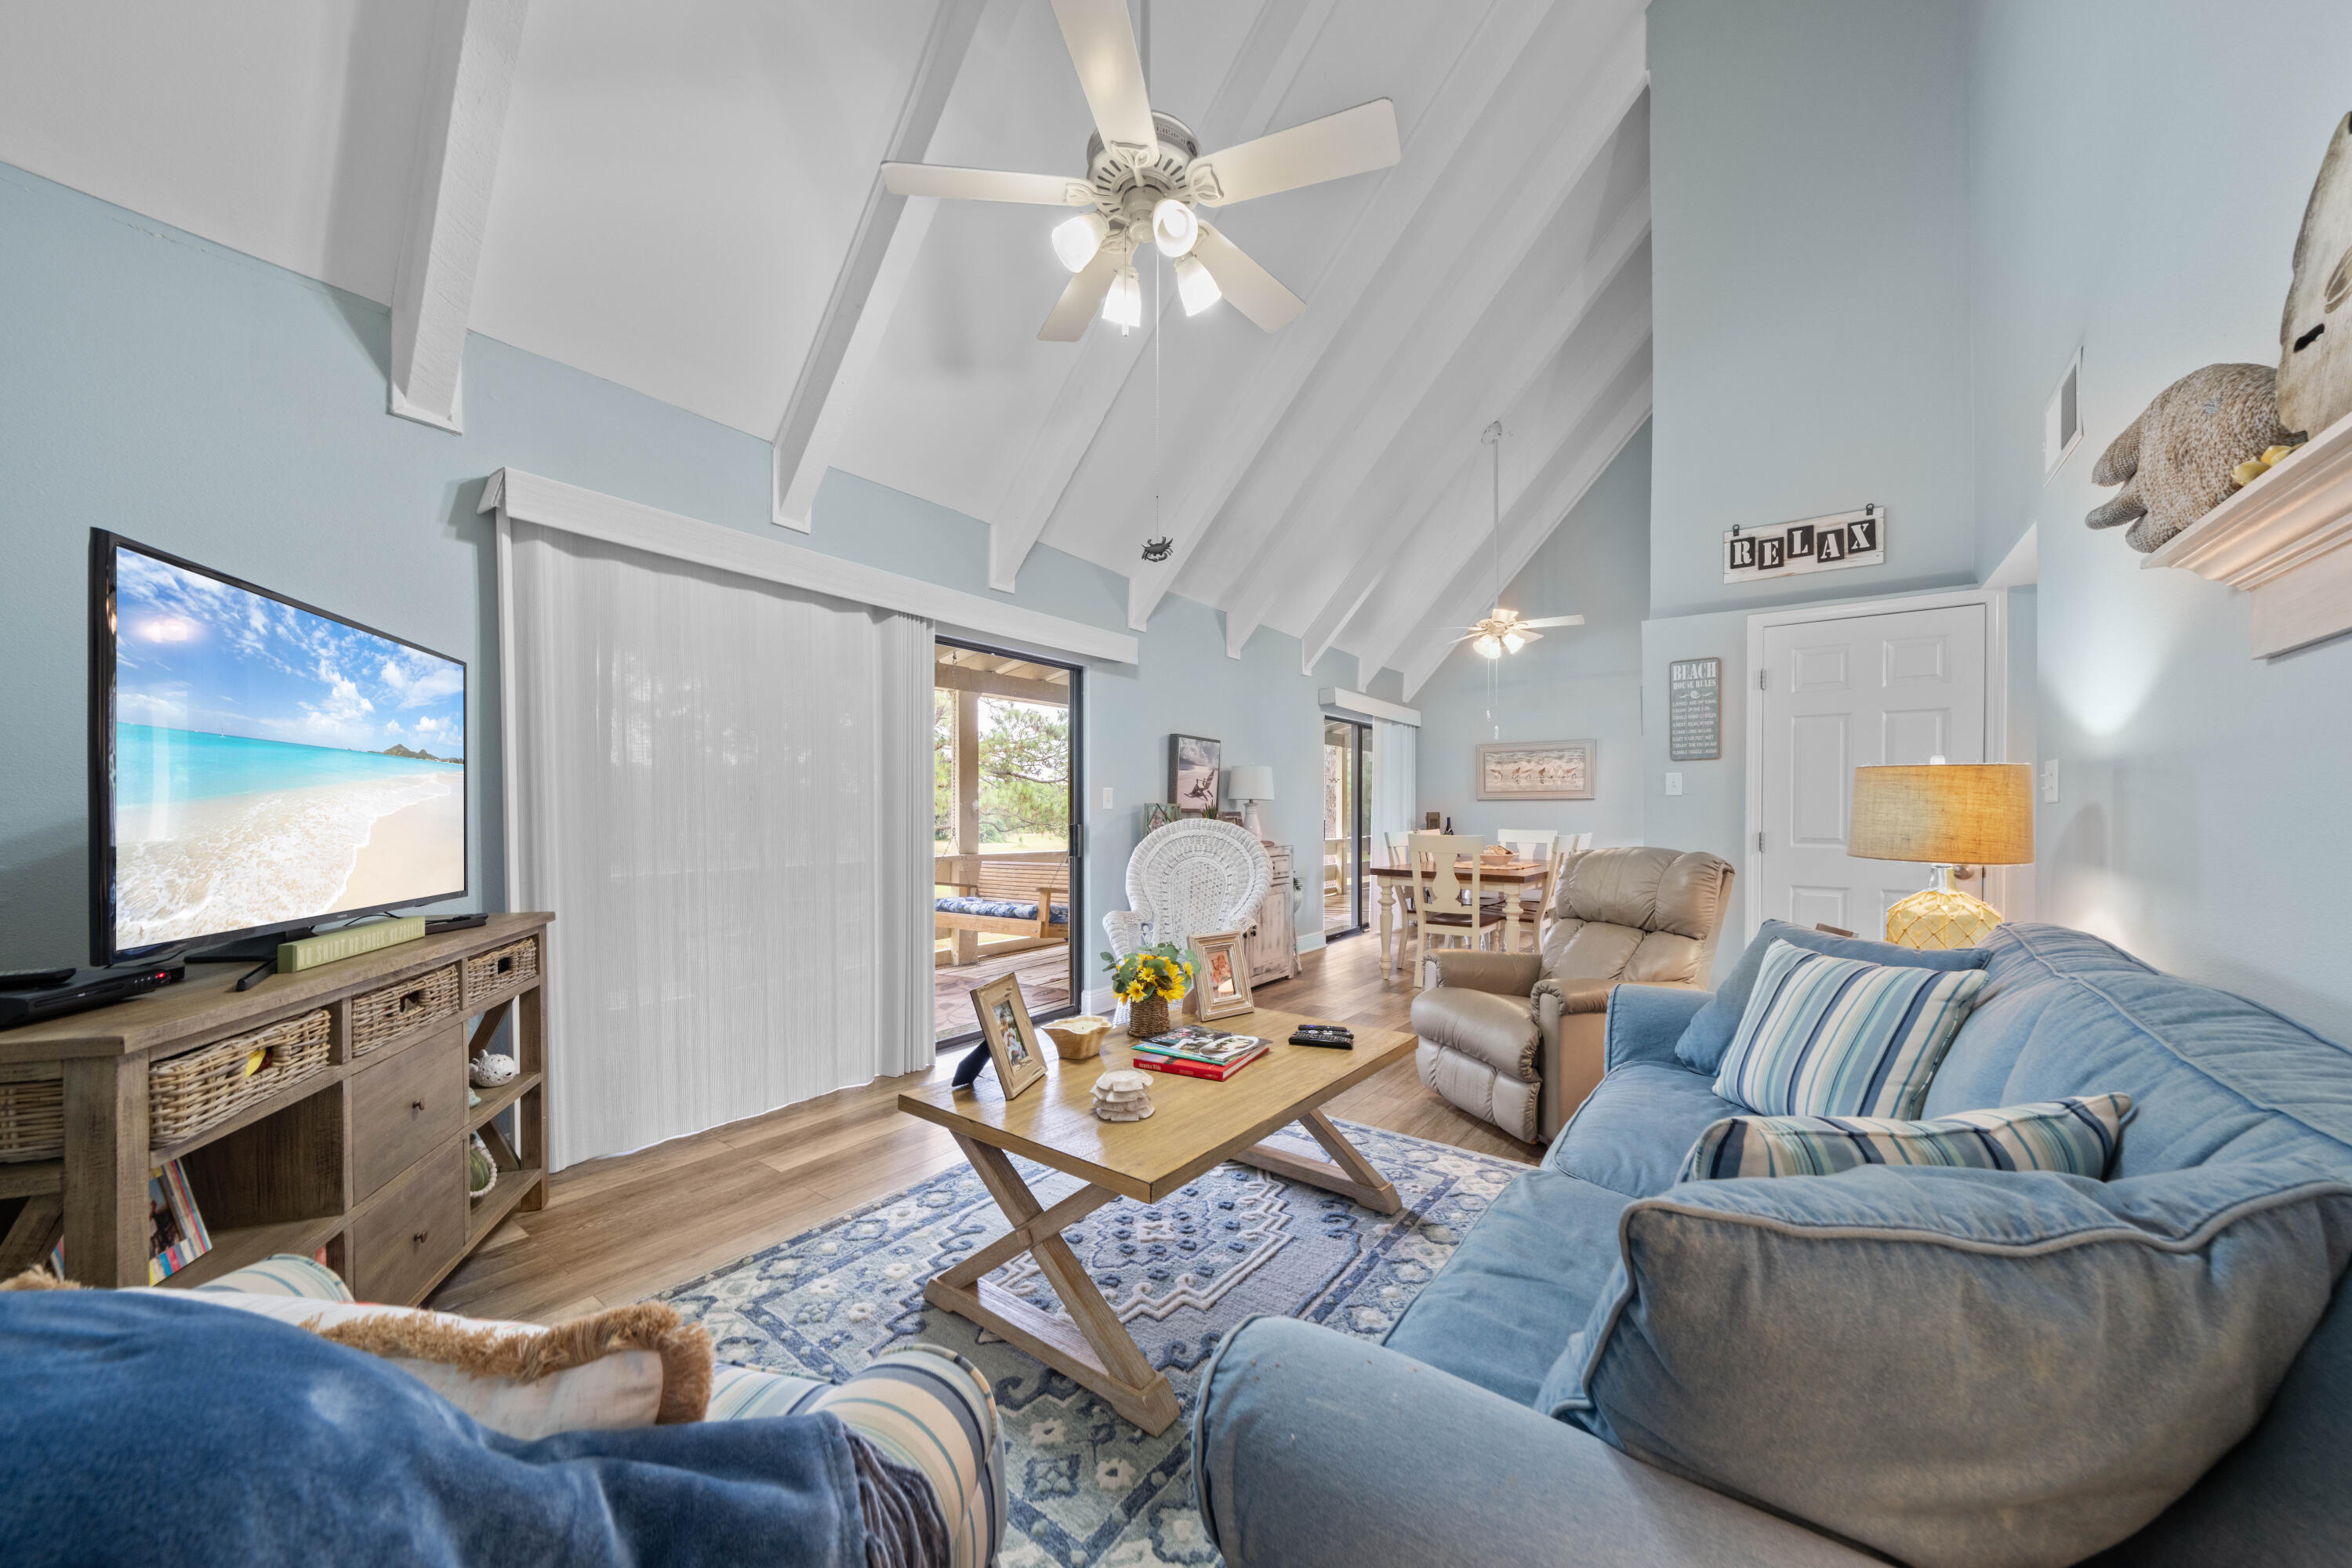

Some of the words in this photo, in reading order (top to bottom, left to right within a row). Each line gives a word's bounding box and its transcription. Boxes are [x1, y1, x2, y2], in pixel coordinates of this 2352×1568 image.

[1733, 523, 1871, 567] RELAX
[1672, 662, 1717, 681] BEACH
[1673, 680, 1694, 690] HOUSE
[1695, 678, 1717, 689] RULES
[299, 947, 312, 967] NO
[316, 938, 346, 963] SHIRT
[348, 936, 359, 955] NO
[390, 927, 397, 943] NO
